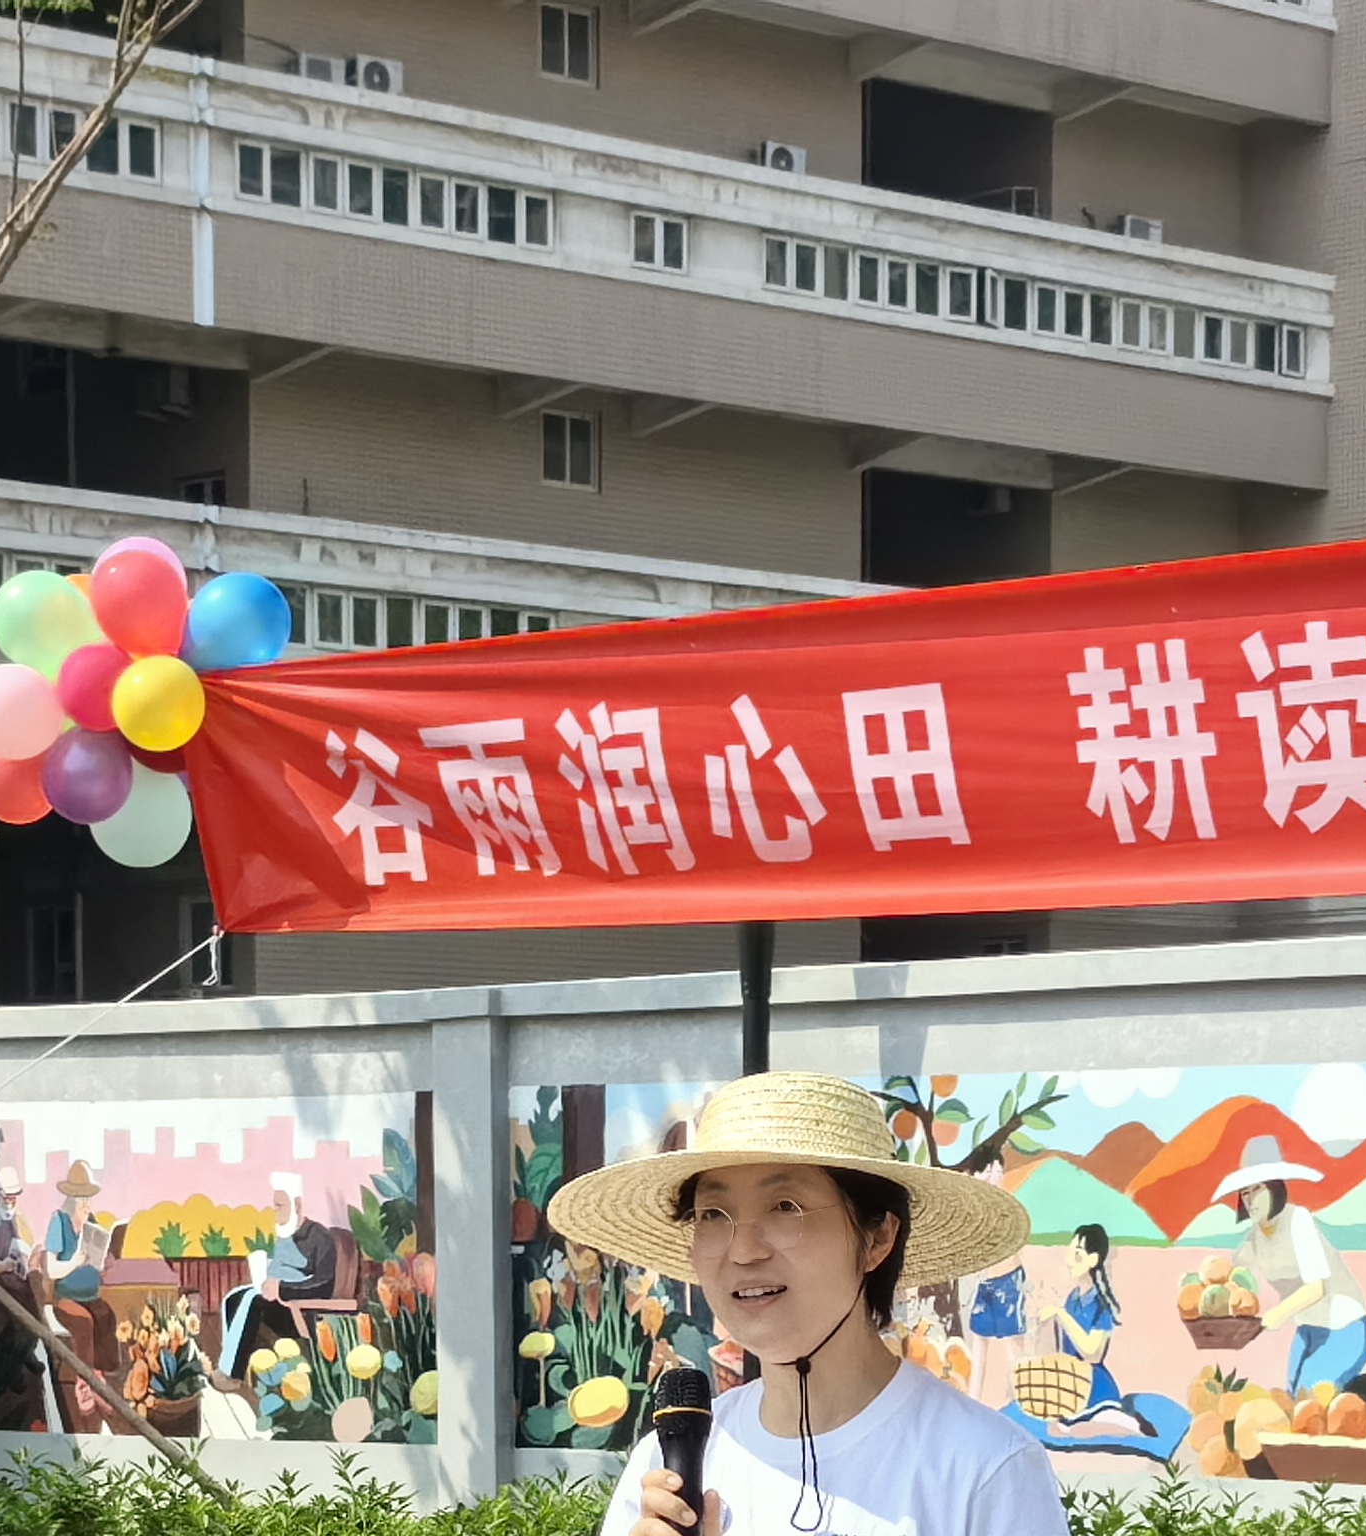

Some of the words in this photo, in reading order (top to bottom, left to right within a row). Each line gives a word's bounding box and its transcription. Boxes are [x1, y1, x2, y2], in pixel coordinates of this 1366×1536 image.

[325, 692, 972, 887] 谷雨润心田
